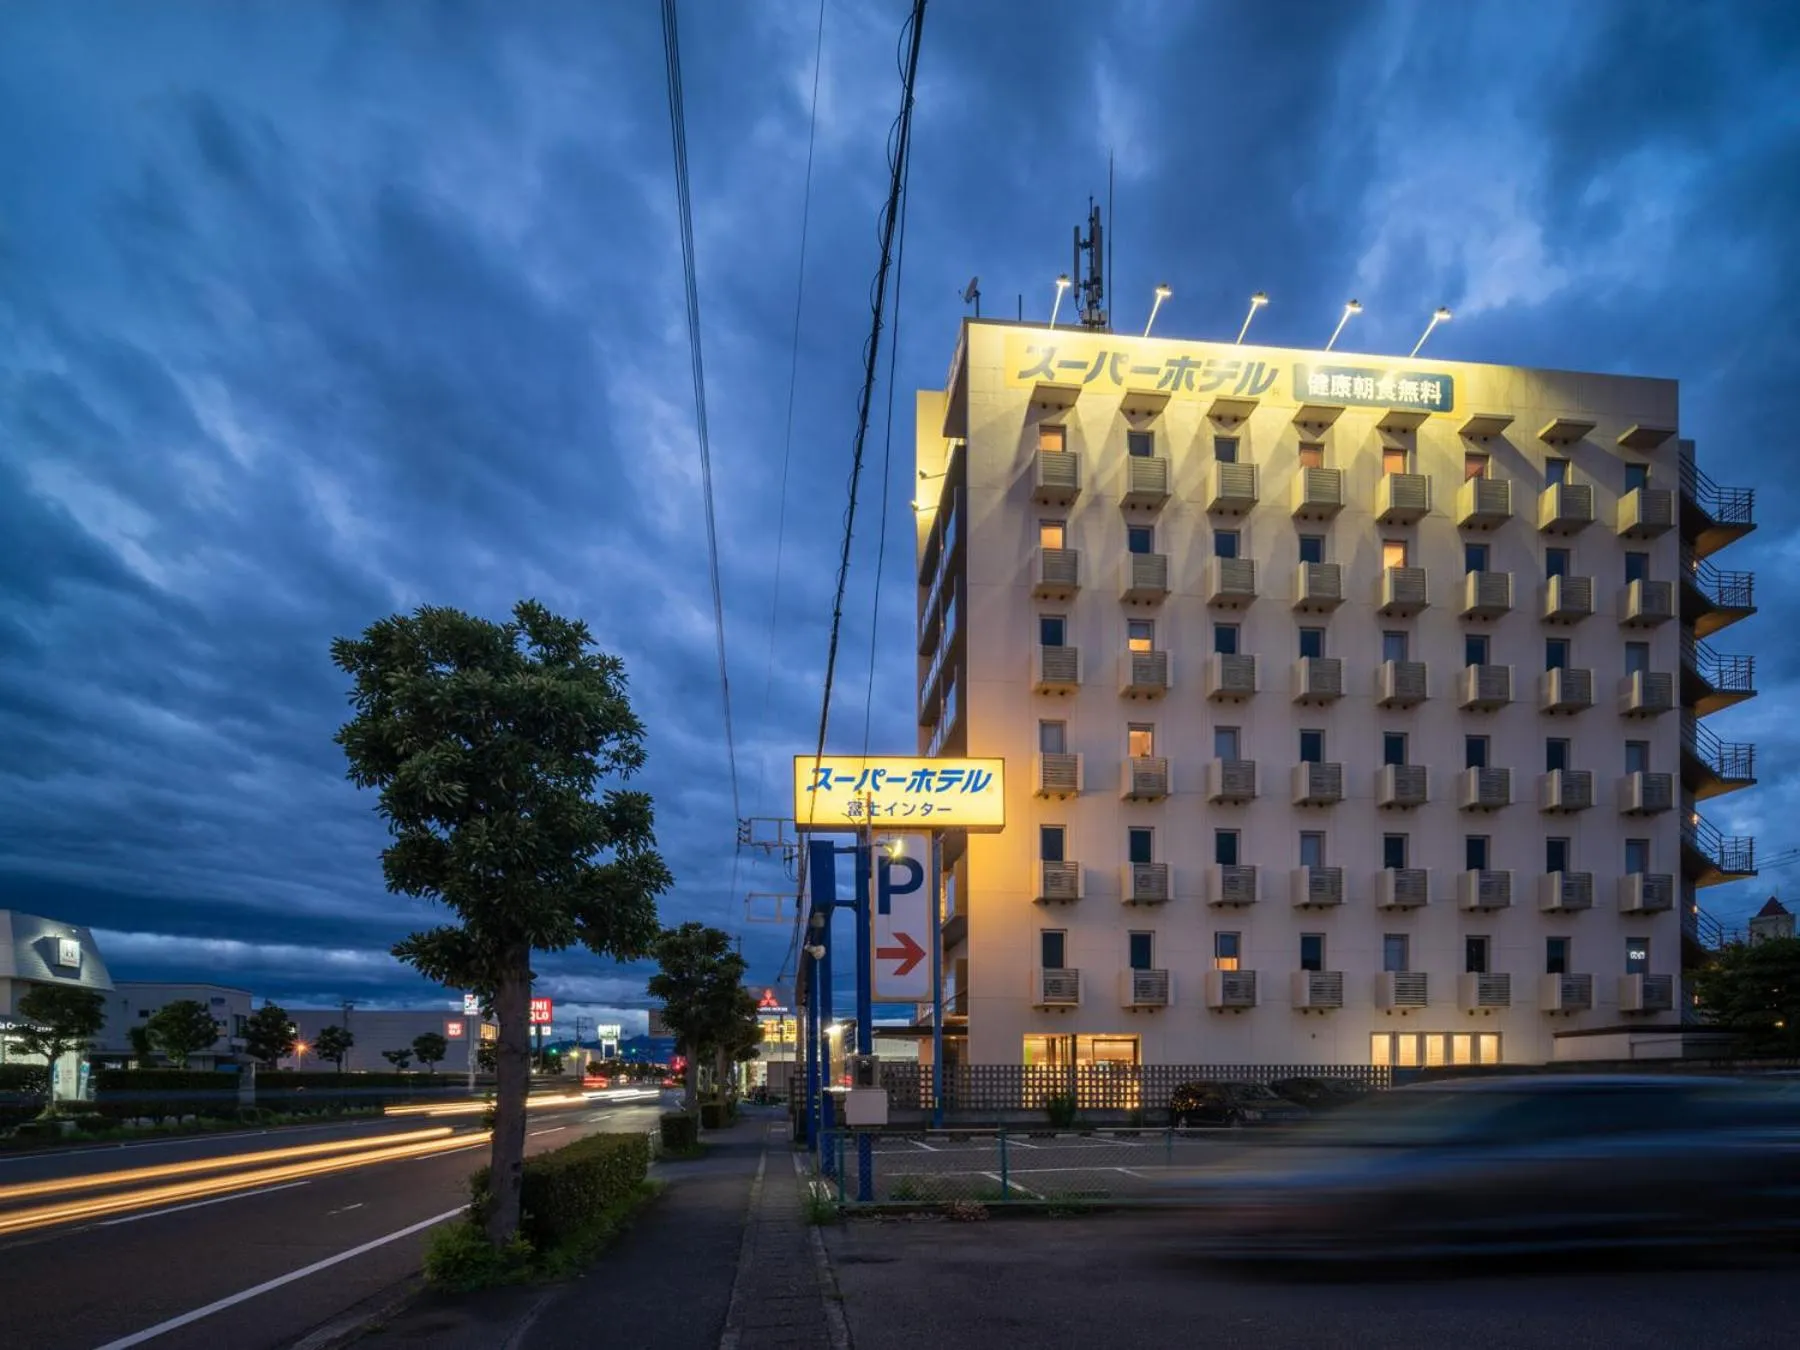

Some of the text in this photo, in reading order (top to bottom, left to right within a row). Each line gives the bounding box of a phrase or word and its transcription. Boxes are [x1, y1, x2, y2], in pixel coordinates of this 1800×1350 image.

[1018, 345, 1279, 396] スーパーホテル
[1307, 372, 1442, 405] 健康朝食無料
[806, 767, 992, 794] スーパーホテル
[847, 801, 952, 817] 富士インター
[878, 855, 924, 915] P
